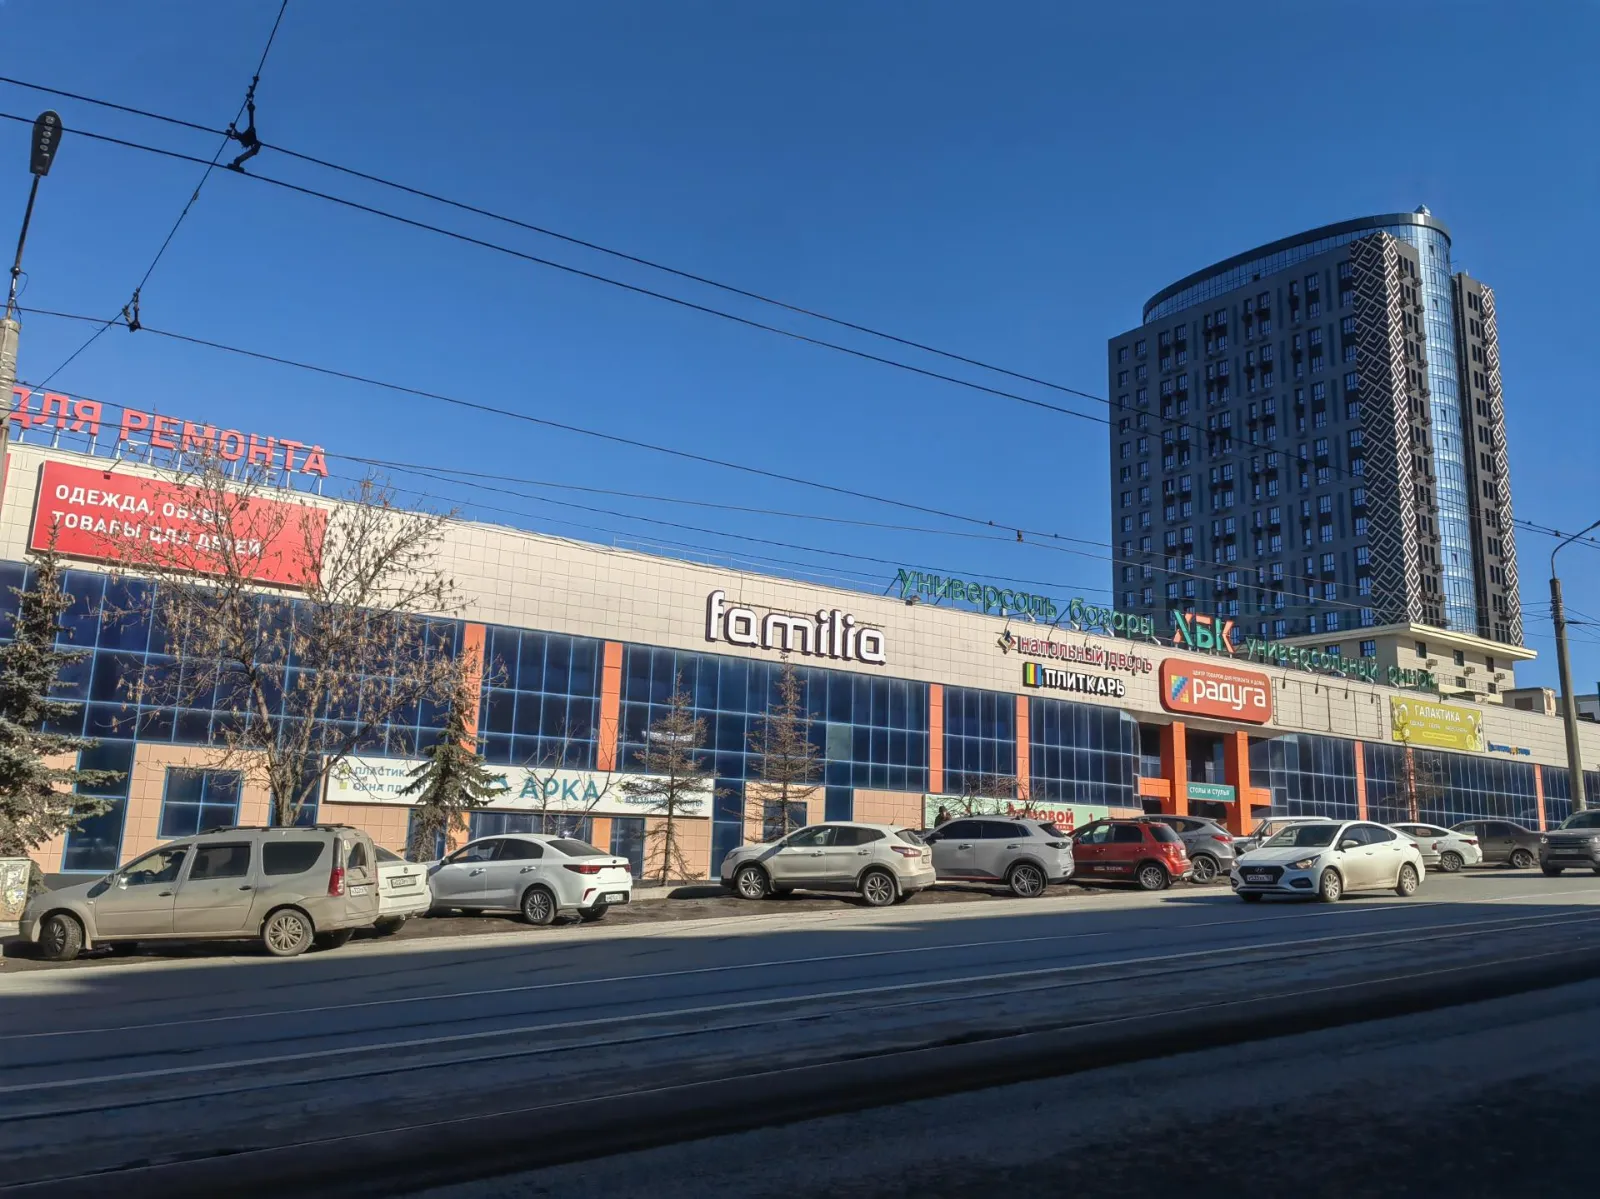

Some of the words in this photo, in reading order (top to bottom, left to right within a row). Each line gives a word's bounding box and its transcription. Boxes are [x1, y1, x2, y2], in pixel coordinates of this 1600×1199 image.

[120, 408, 328, 477] РЕМОНТА
[56, 484, 154, 516] ОДЕЖДА,
[706, 590, 886, 665] familia
[1173, 608, 1235, 654] ХБК
[1019, 637, 1104, 665] напольный
[1108, 652, 1153, 674] дворъ
[1044, 668, 1126, 697] ПЛИТКАРЬ
[1192, 678, 1266, 711] радуга
[1414, 704, 1461, 723] ГАЛАКТИКА
